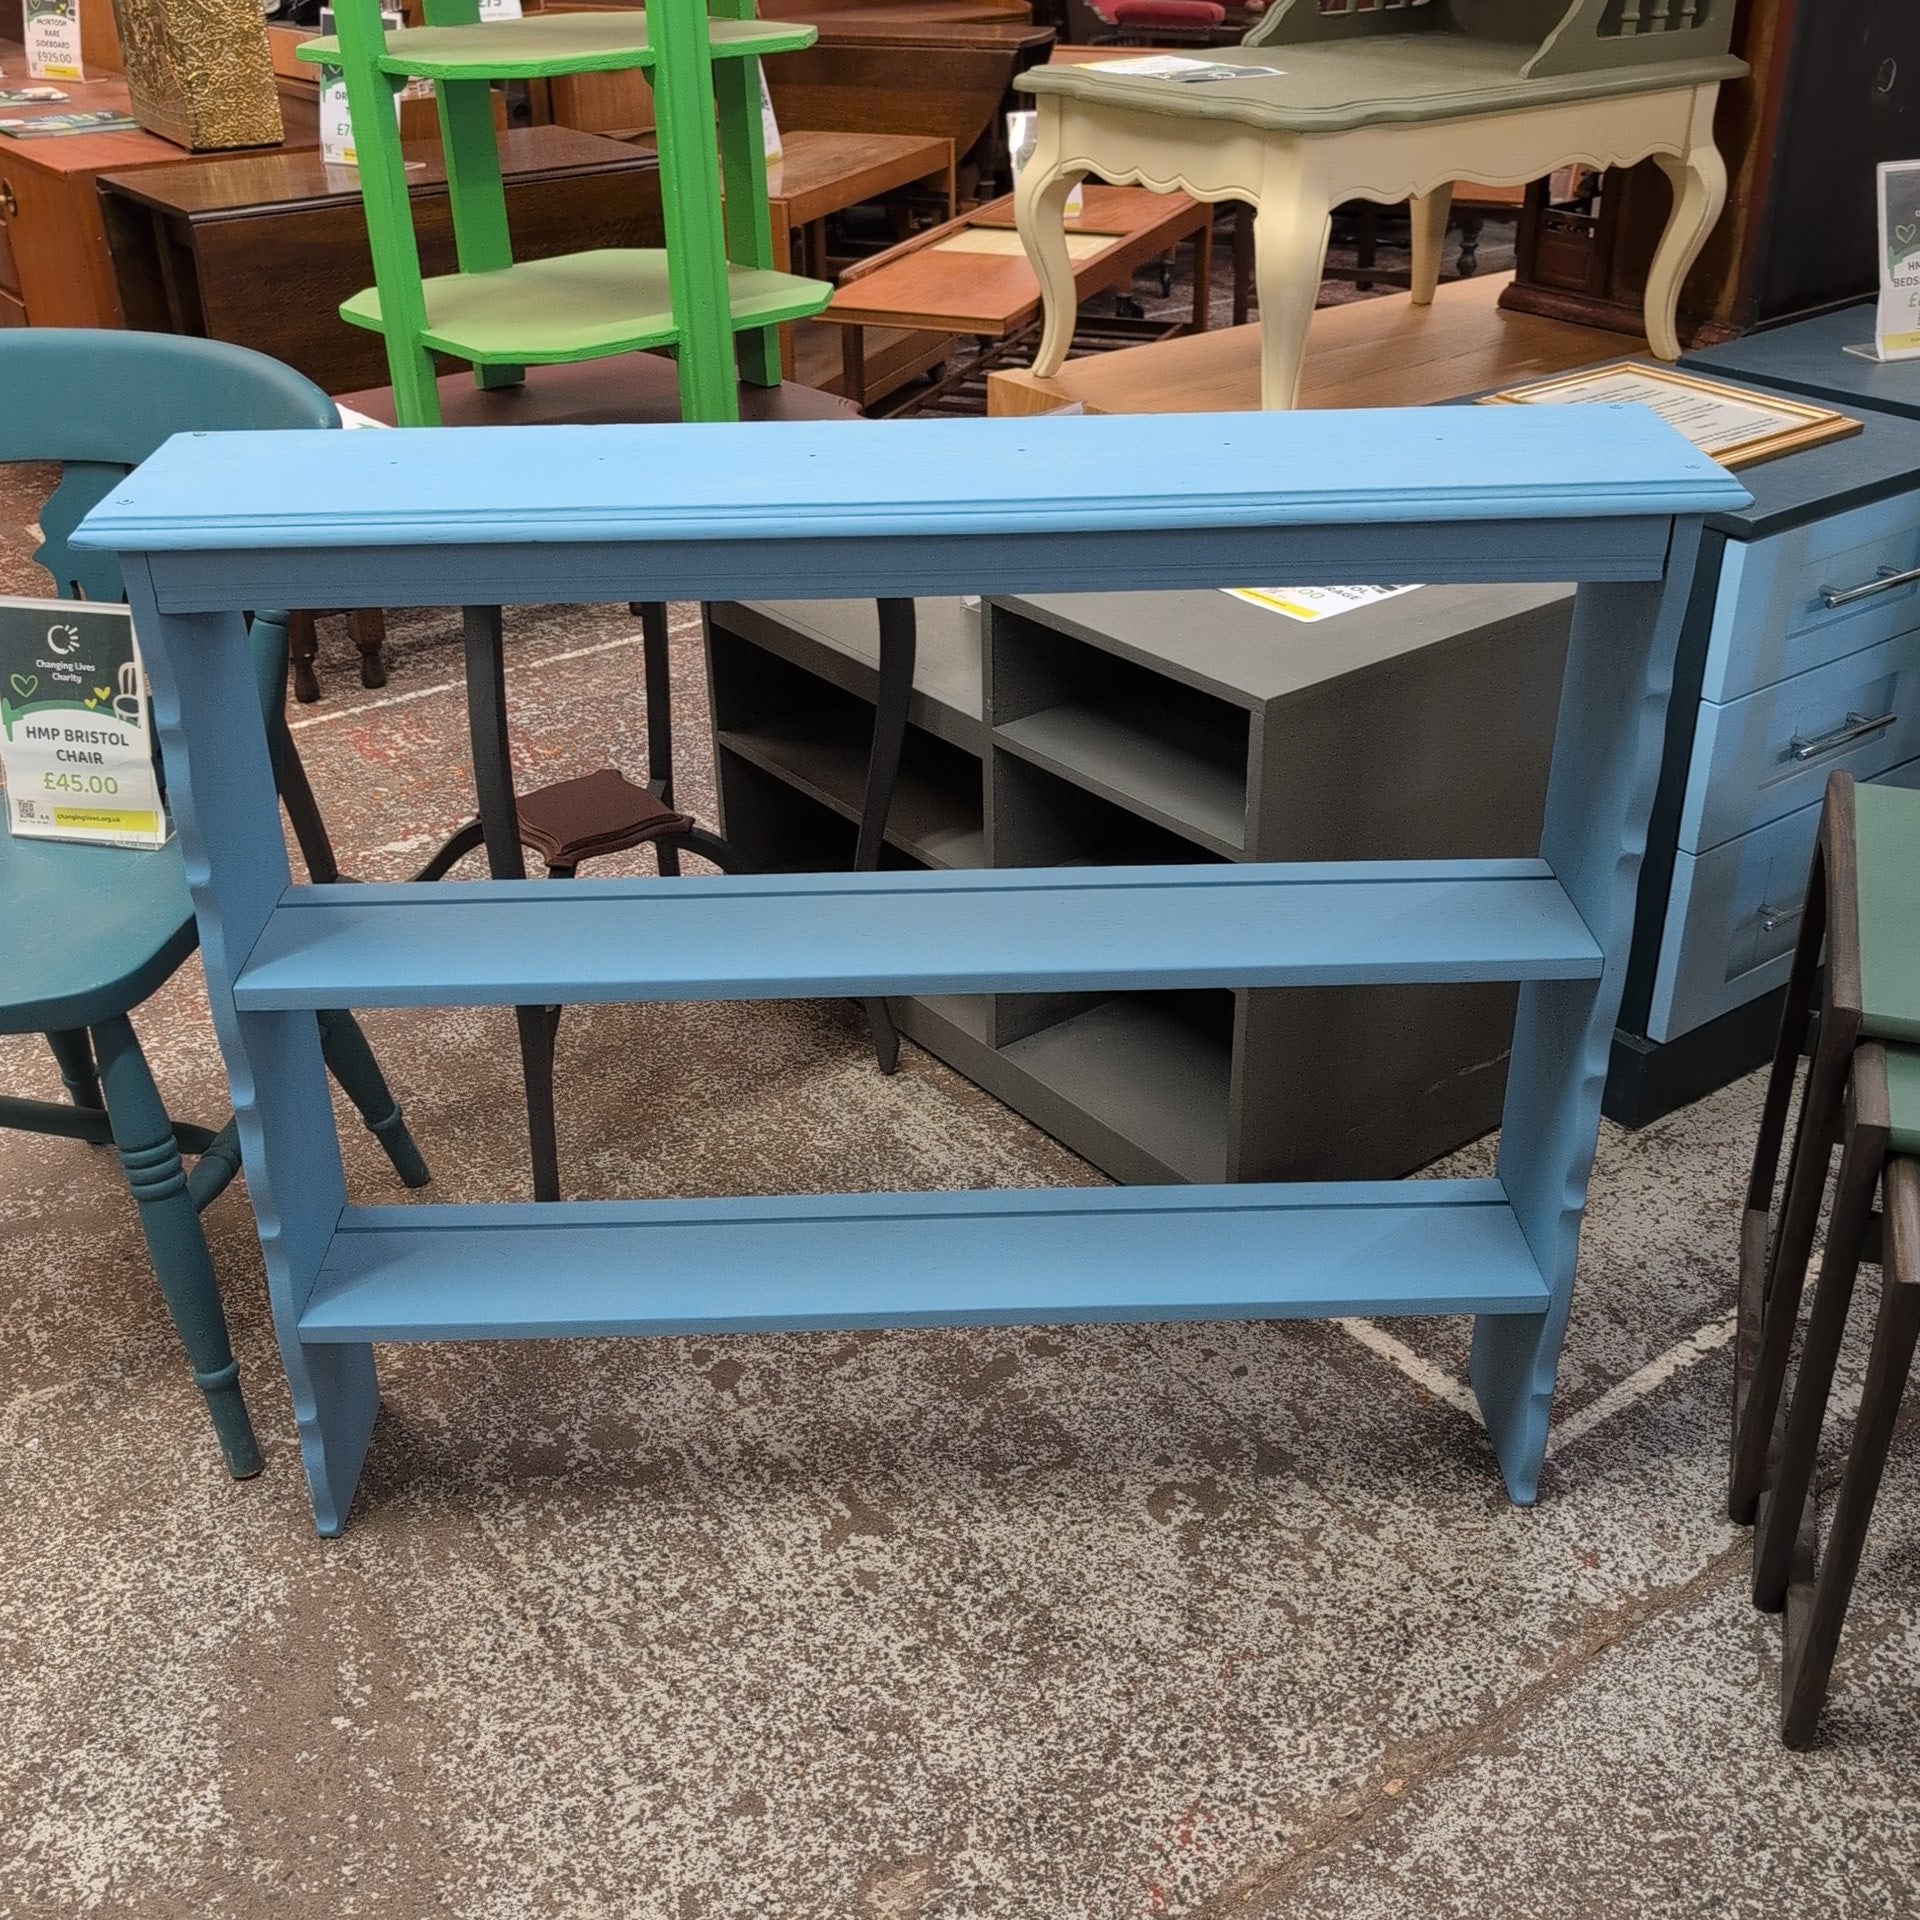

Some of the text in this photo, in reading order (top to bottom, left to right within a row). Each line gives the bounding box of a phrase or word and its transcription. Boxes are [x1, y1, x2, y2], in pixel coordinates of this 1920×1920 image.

[36, 39, 70, 49] SIDEBOARD
[37, 51, 72, 64] £925.00
[335, 91, 348, 100] DR
[337, 122, 352, 136] £7
[1893, 276, 1920, 288] BEDS
[1324, 586, 1363, 600] RAGE
[35, 658, 96, 673] Changing Lives
[51, 671, 82, 684] Charity
[26, 725, 130, 746] HMP BRISTOL
[56, 749, 104, 765] CHAIR
[44, 771, 119, 795] £45.00
